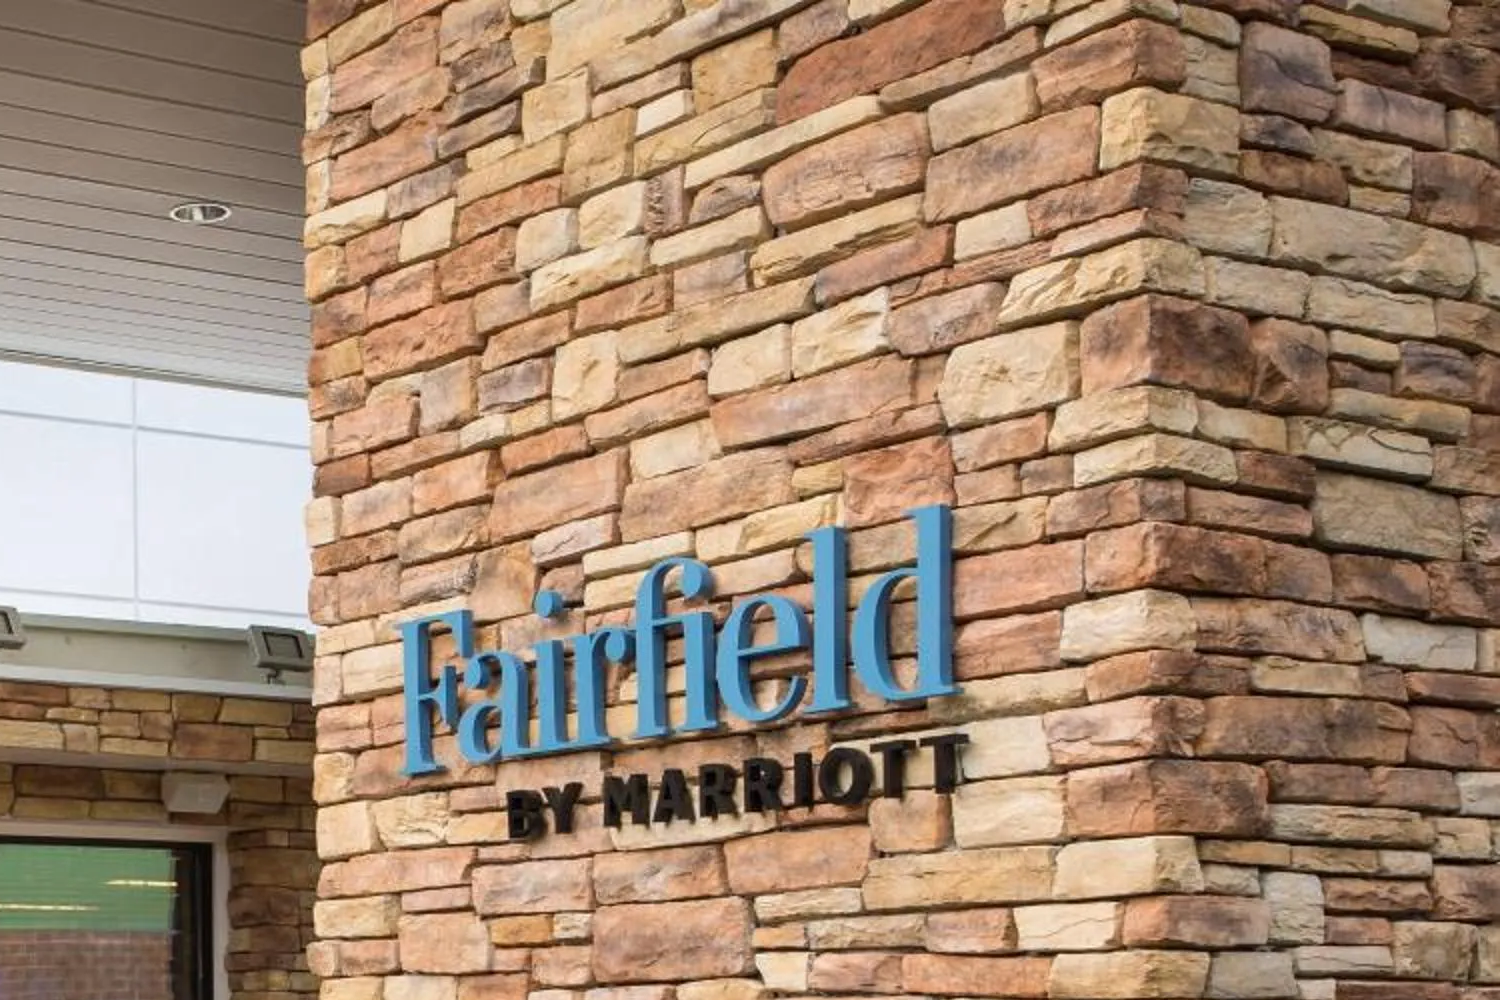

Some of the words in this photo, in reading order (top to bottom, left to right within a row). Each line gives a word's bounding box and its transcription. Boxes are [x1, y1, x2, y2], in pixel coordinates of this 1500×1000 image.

[394, 504, 965, 775] Fairfield
[504, 782, 583, 840] BY
[602, 733, 969, 828] MARRIOTT
